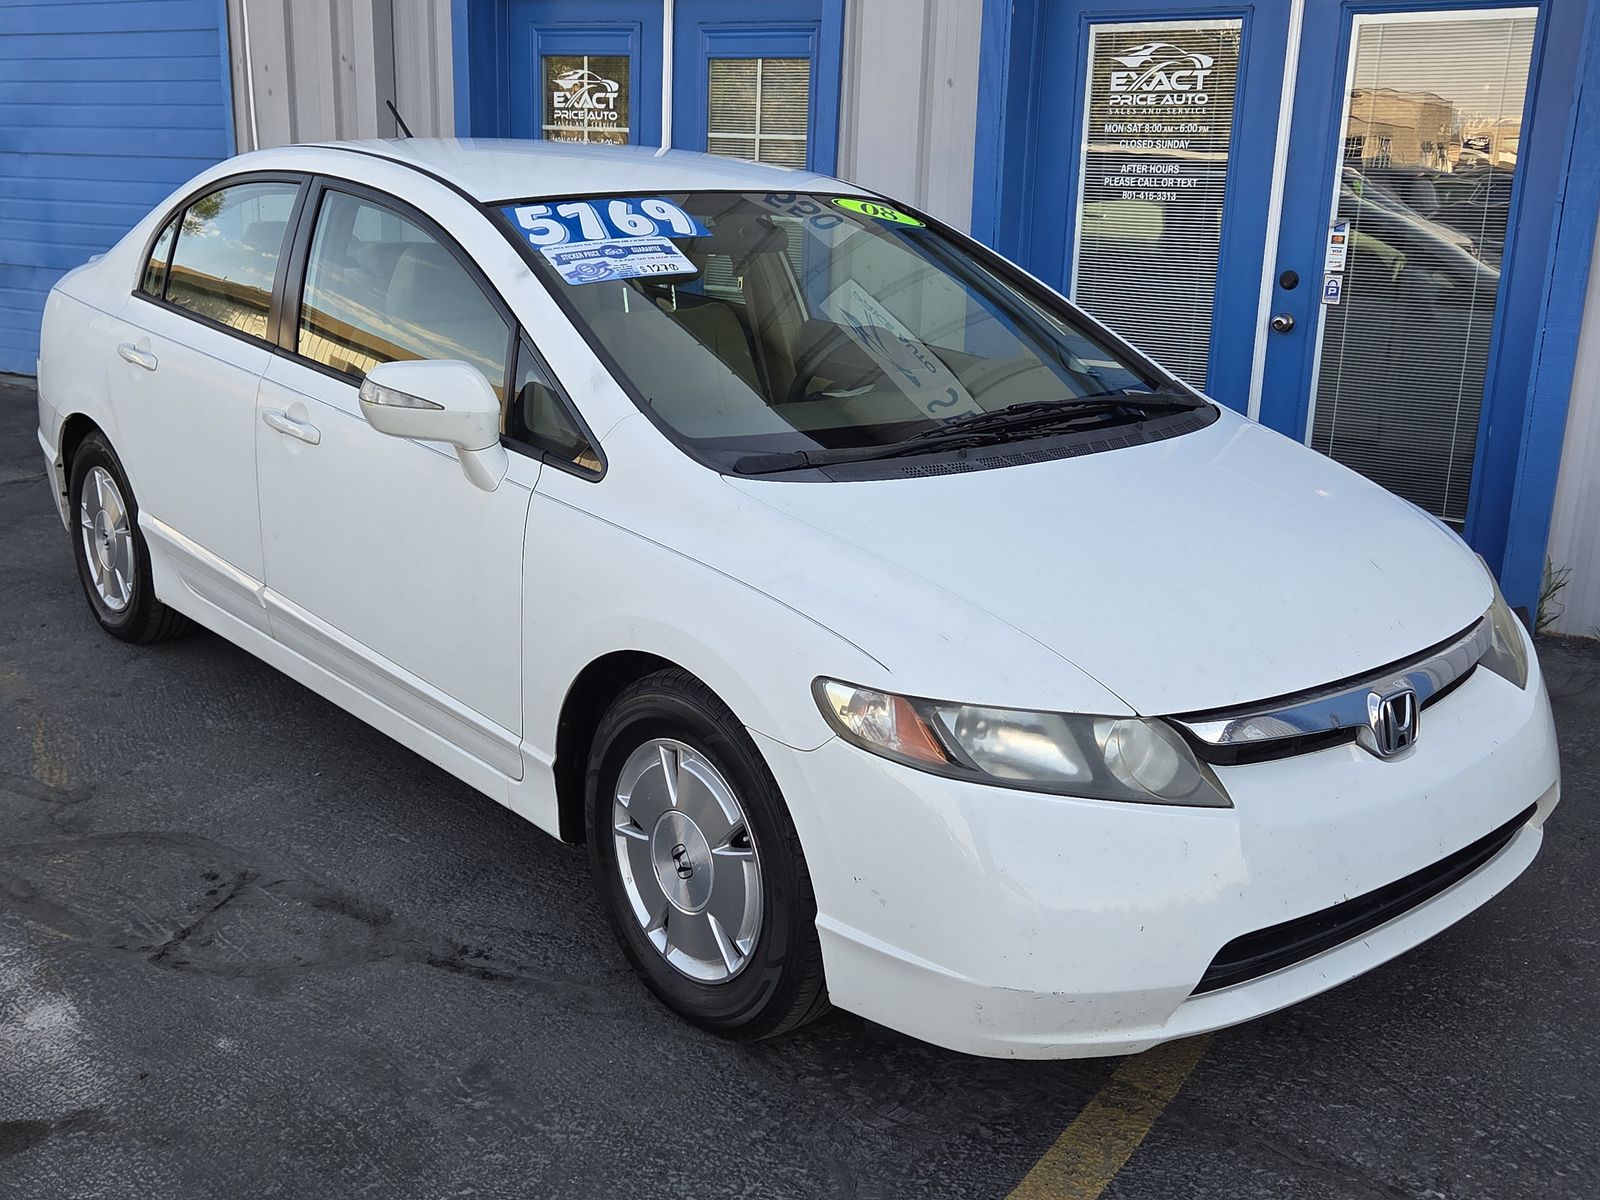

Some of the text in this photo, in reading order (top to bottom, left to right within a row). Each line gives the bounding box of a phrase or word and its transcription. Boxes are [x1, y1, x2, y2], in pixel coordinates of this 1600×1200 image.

[1110, 70, 1212, 91] EXACT
[553, 91, 618, 109] EXACT
[1109, 93, 1209, 106] PRICE AUTO
[553, 110, 618, 120] PRICE AUTO
[1166, 107, 1208, 115] SERVICE
[1144, 124, 1162, 133] 8:00
[1179, 124, 1198, 133] 6:00
[1119, 140, 1190, 149] CLOSED SUNDAY
[1120, 165, 1180, 174] AFTER HOURS
[1103, 177, 1199, 187] PLEASE CALL OR TEXT
[860, 203, 898, 220] 08
[514, 199, 697, 245] 5769
